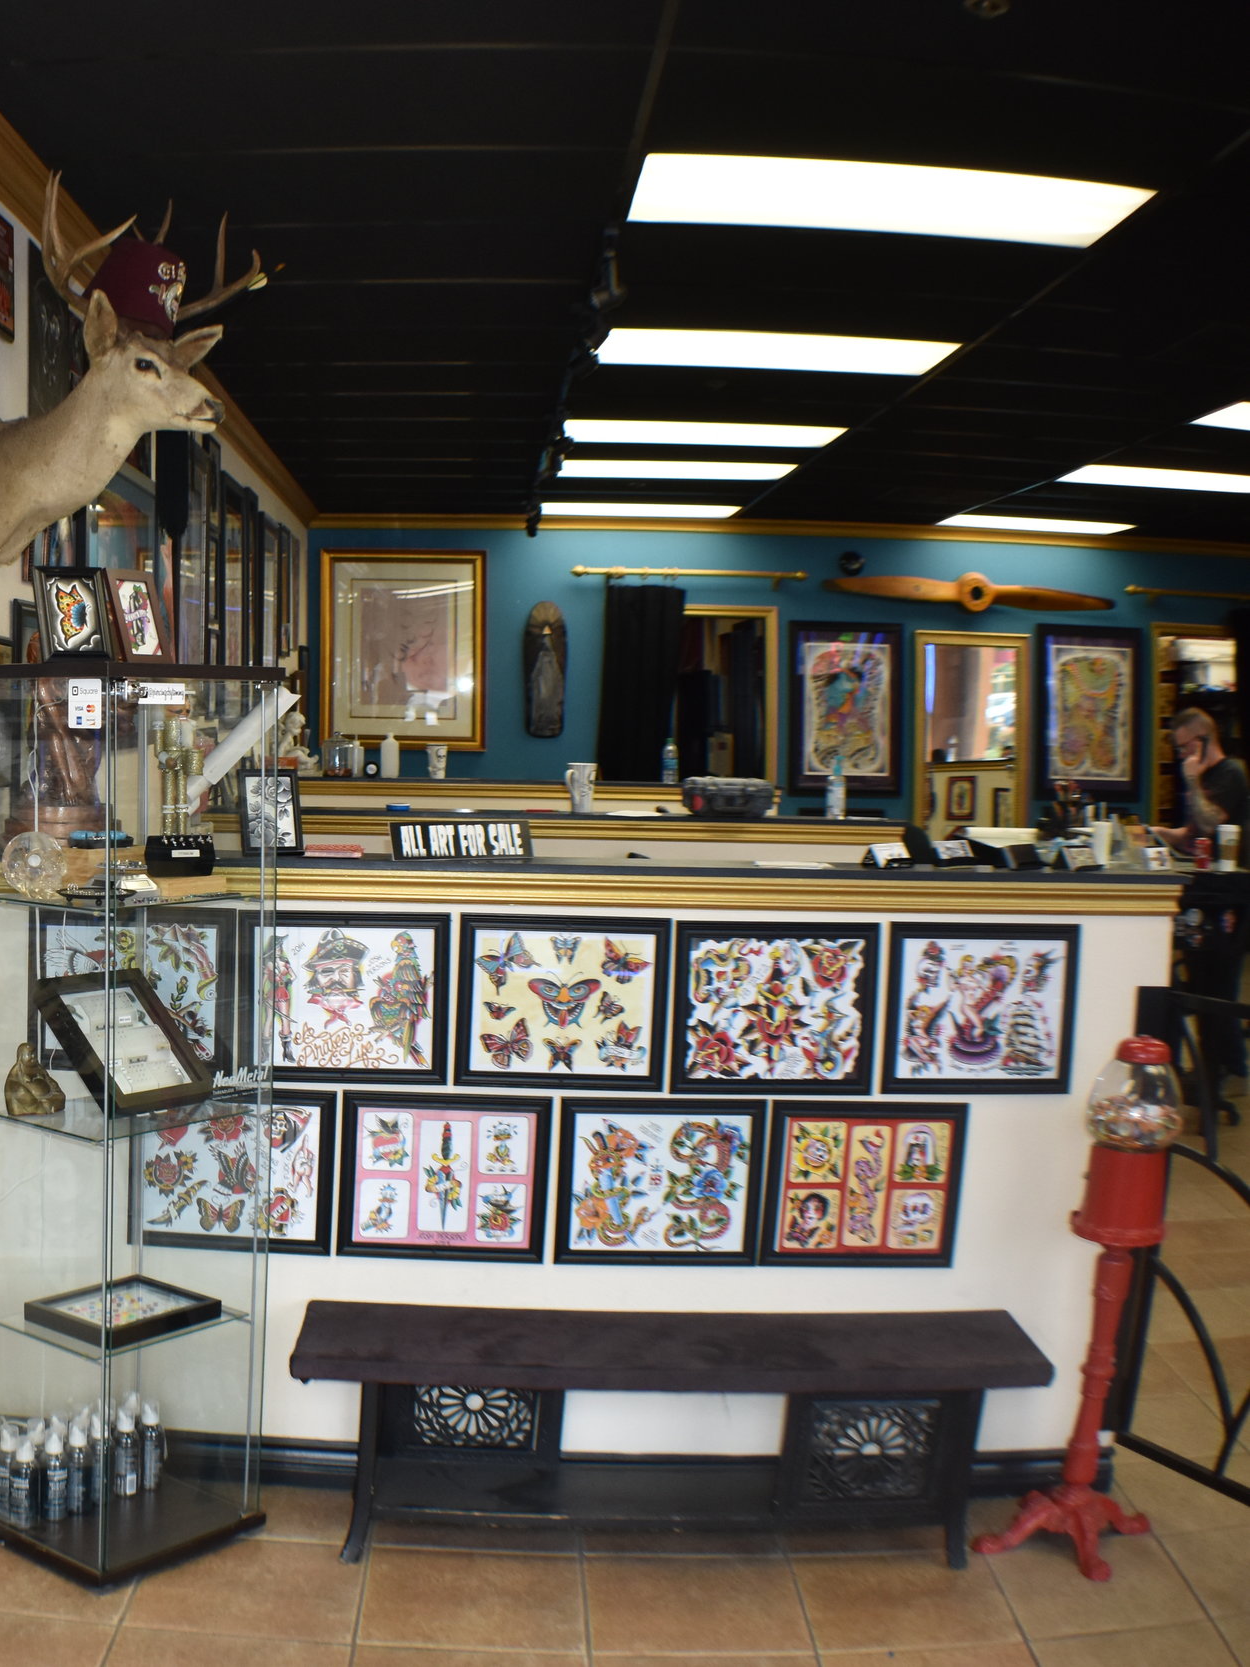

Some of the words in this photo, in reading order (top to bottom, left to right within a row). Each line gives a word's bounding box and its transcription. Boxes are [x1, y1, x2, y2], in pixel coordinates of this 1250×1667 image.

[79, 686, 99, 696] Square
[400, 824, 427, 858] ALL
[428, 824, 455, 857] ART
[457, 823, 487, 857] FOR
[488, 823, 524, 856] SALE
[212, 1065, 269, 1089] NeoMetal
